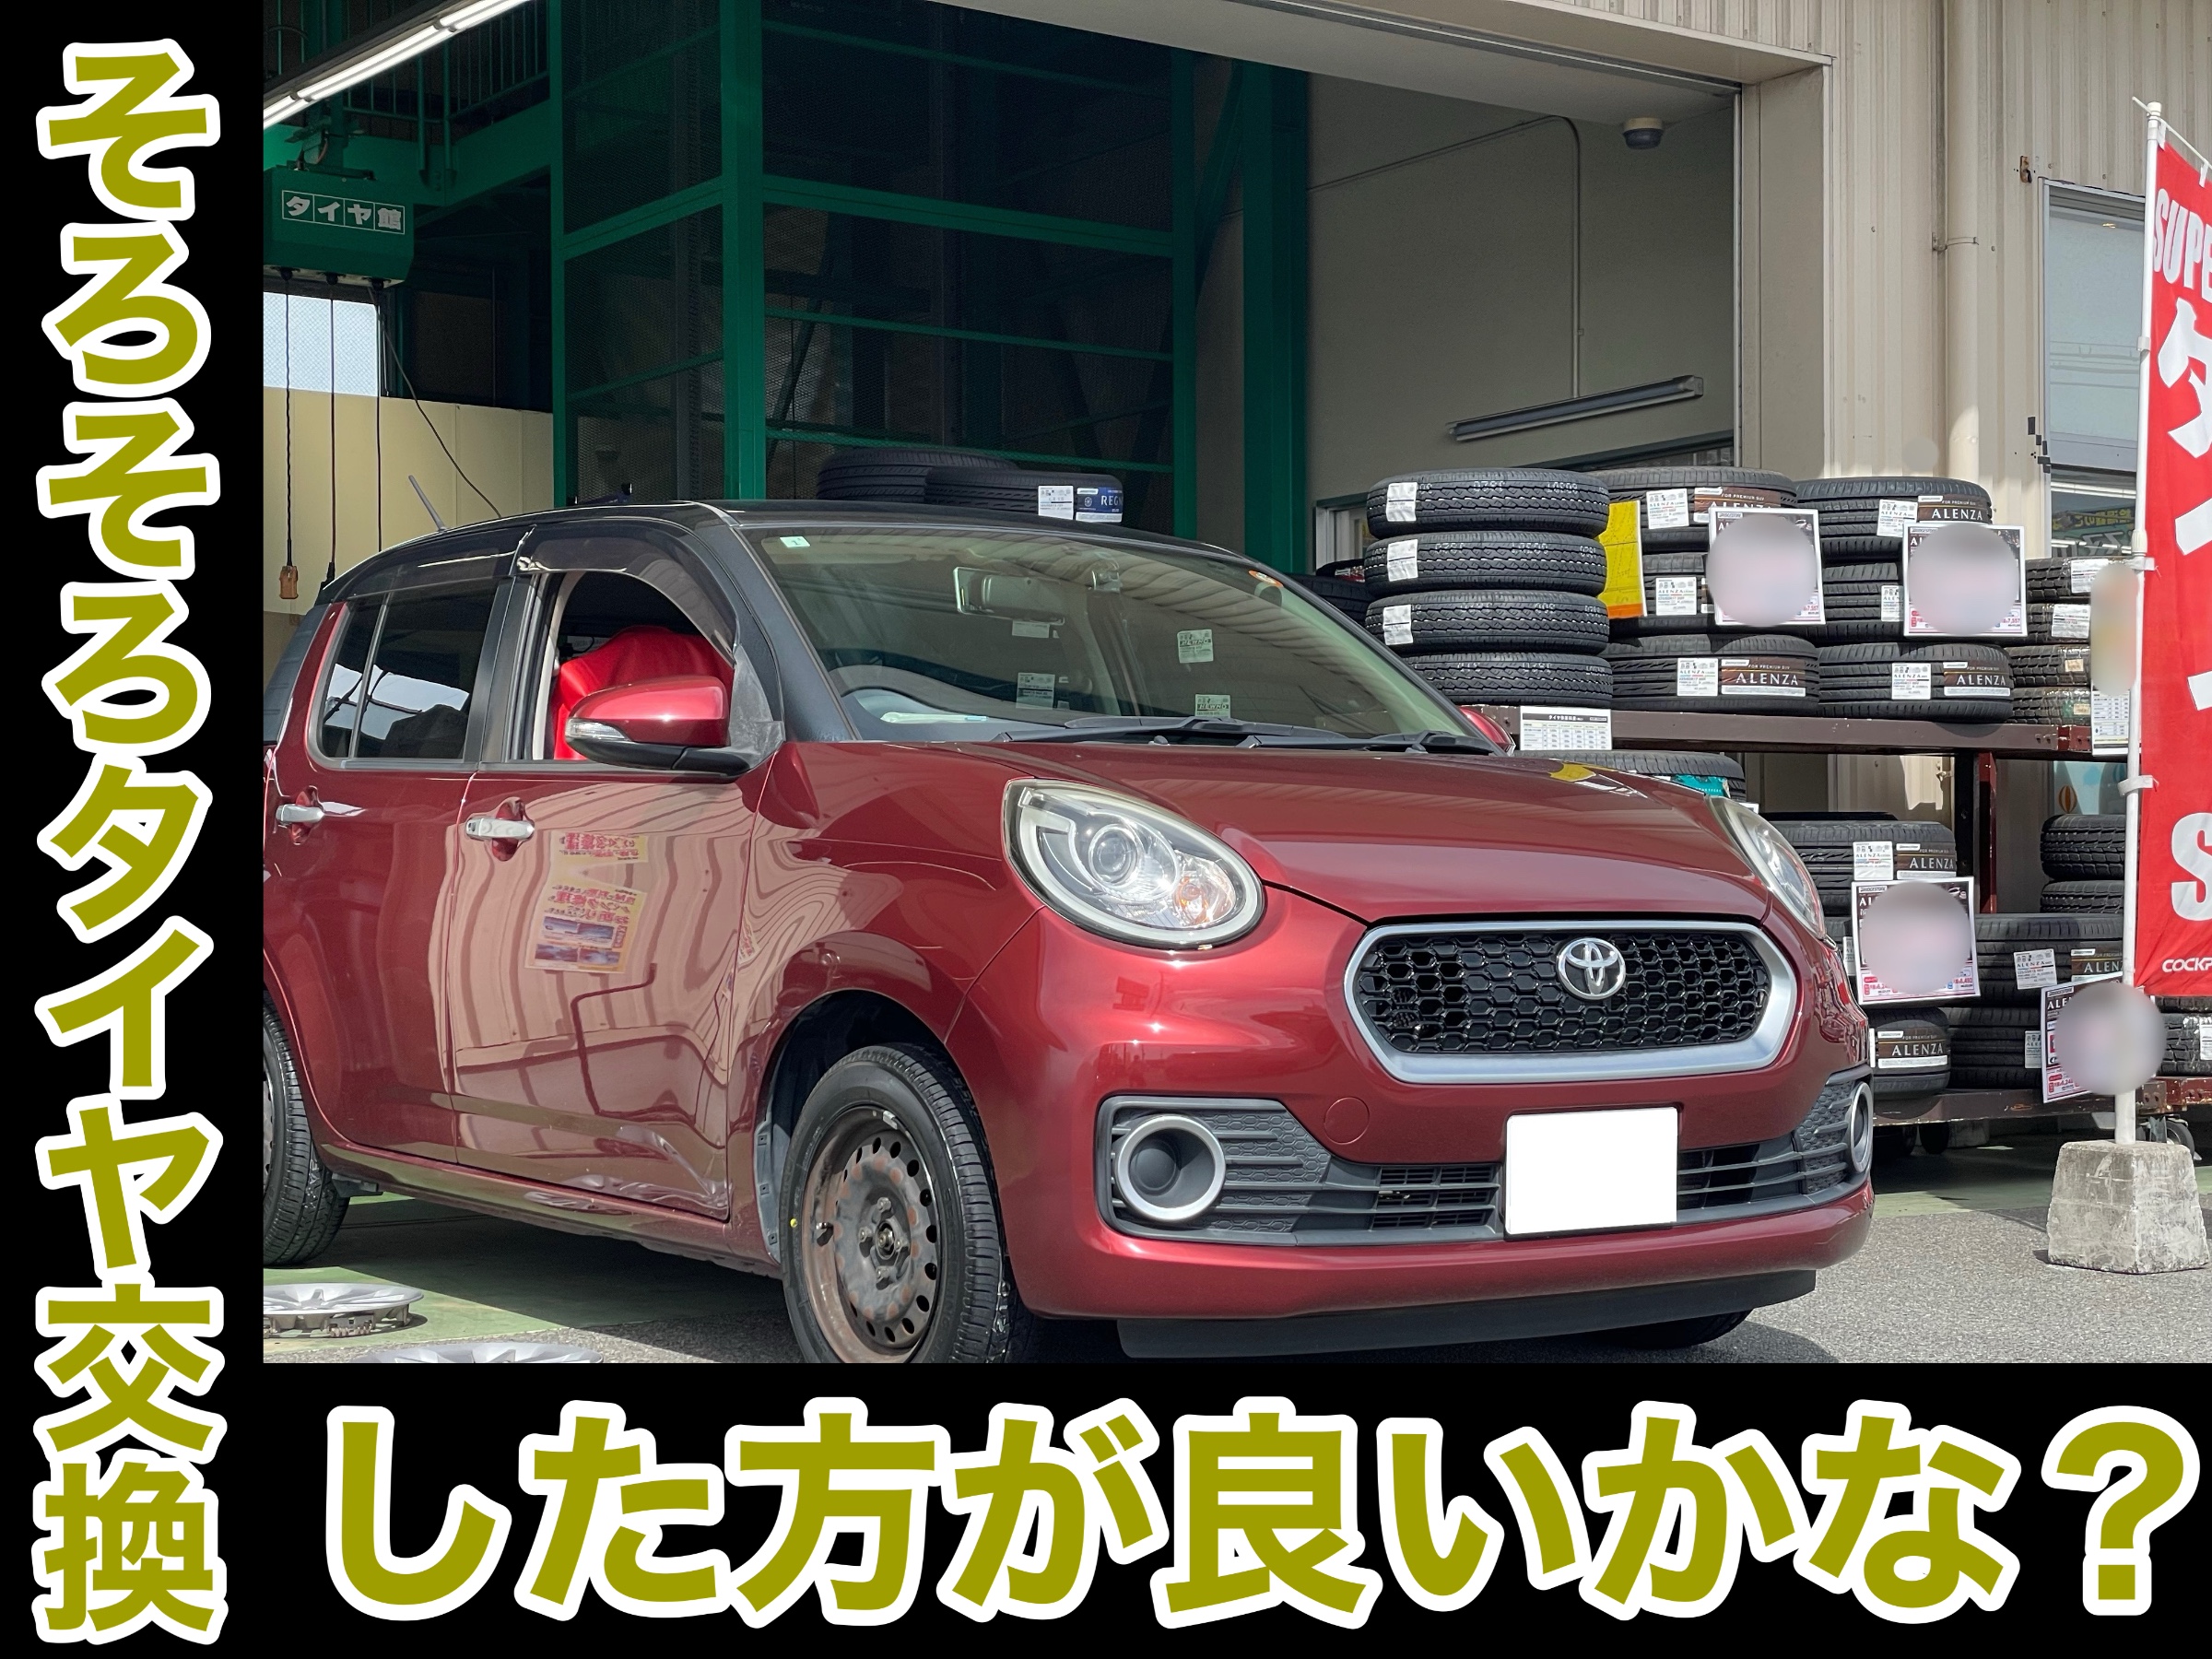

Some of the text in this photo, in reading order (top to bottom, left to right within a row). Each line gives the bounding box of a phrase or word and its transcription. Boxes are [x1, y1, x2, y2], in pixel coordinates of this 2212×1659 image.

[286, 196, 402, 230] タイヤ館
[1931, 508, 1983, 520] ALENZA
[1735, 672, 1798, 685] ALENZA
[1957, 675, 2006, 686] ALENZA
[1910, 857, 1954, 869] ALENZA
[1892, 1043, 1943, 1056] ALENZA
